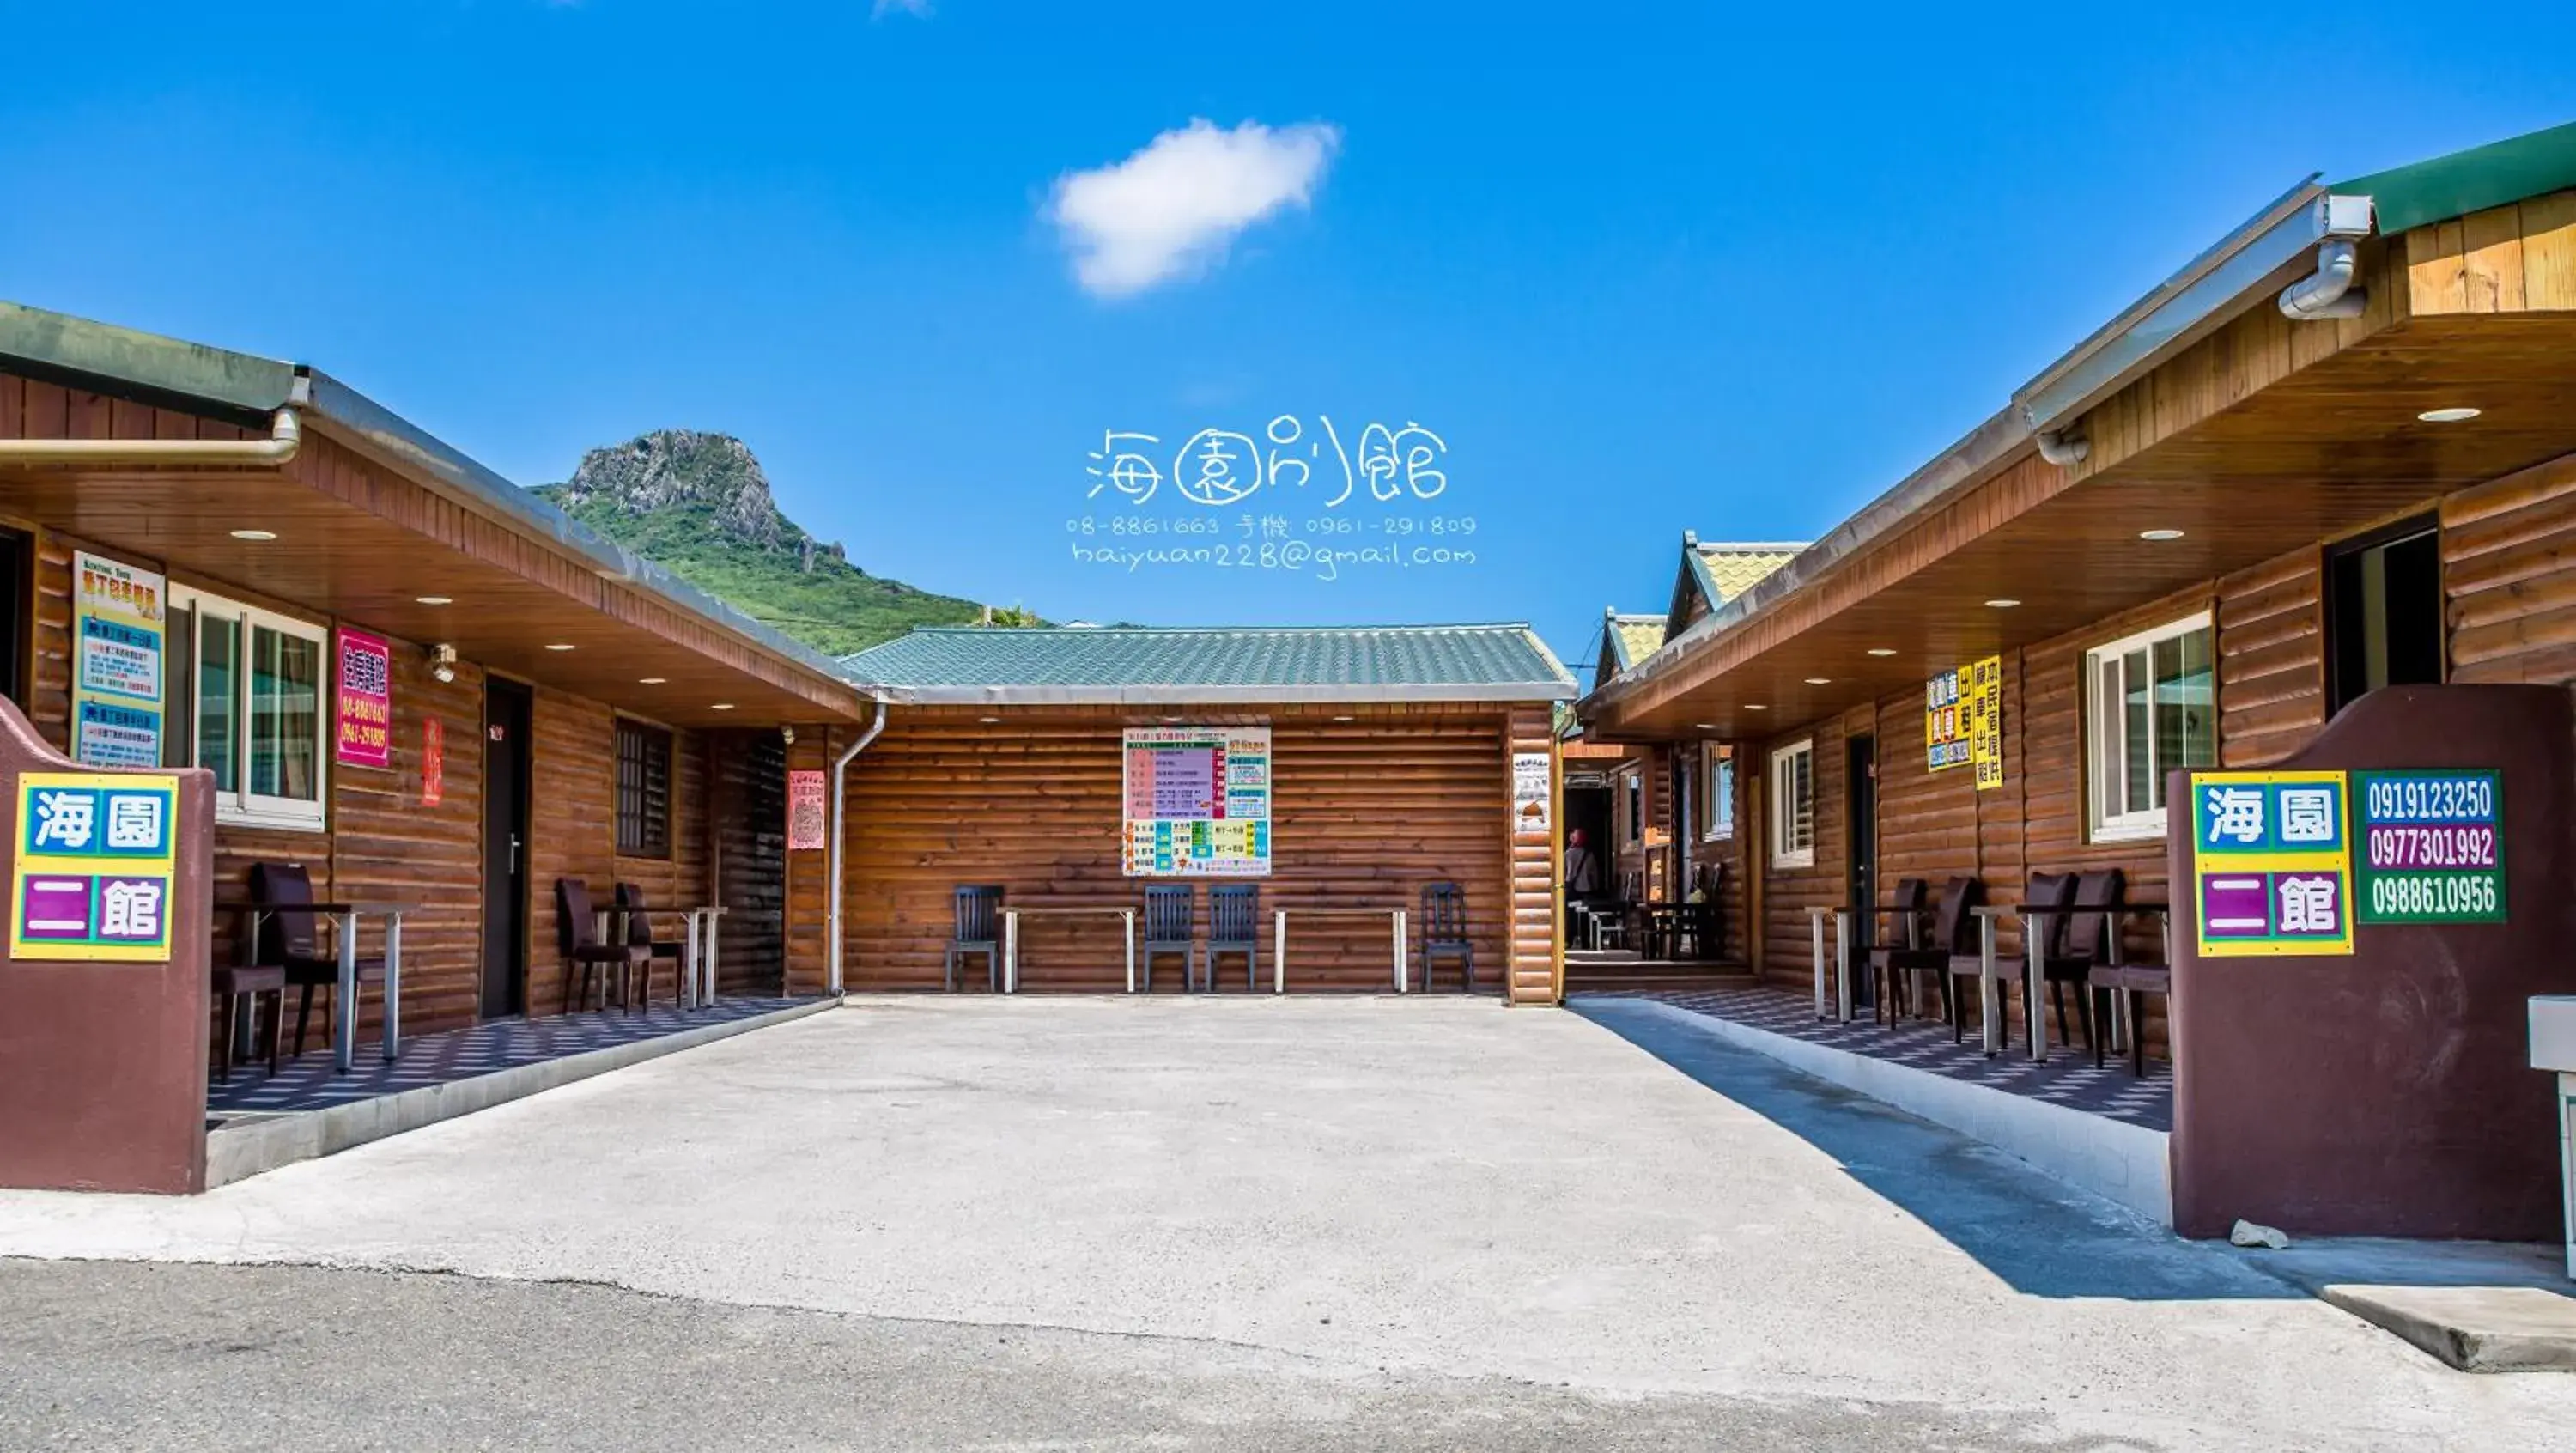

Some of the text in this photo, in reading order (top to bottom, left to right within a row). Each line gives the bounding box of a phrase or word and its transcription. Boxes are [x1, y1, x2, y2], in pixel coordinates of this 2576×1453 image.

[35, 791, 163, 848] 海園
[2208, 787, 2334, 843] 海園
[2368, 781, 2492, 819] 0919123250
[2370, 828, 2494, 866] 0977301992
[27, 880, 161, 936] 二館
[2209, 876, 2336, 932] 二館
[2372, 876, 2497, 914] 0988610956
